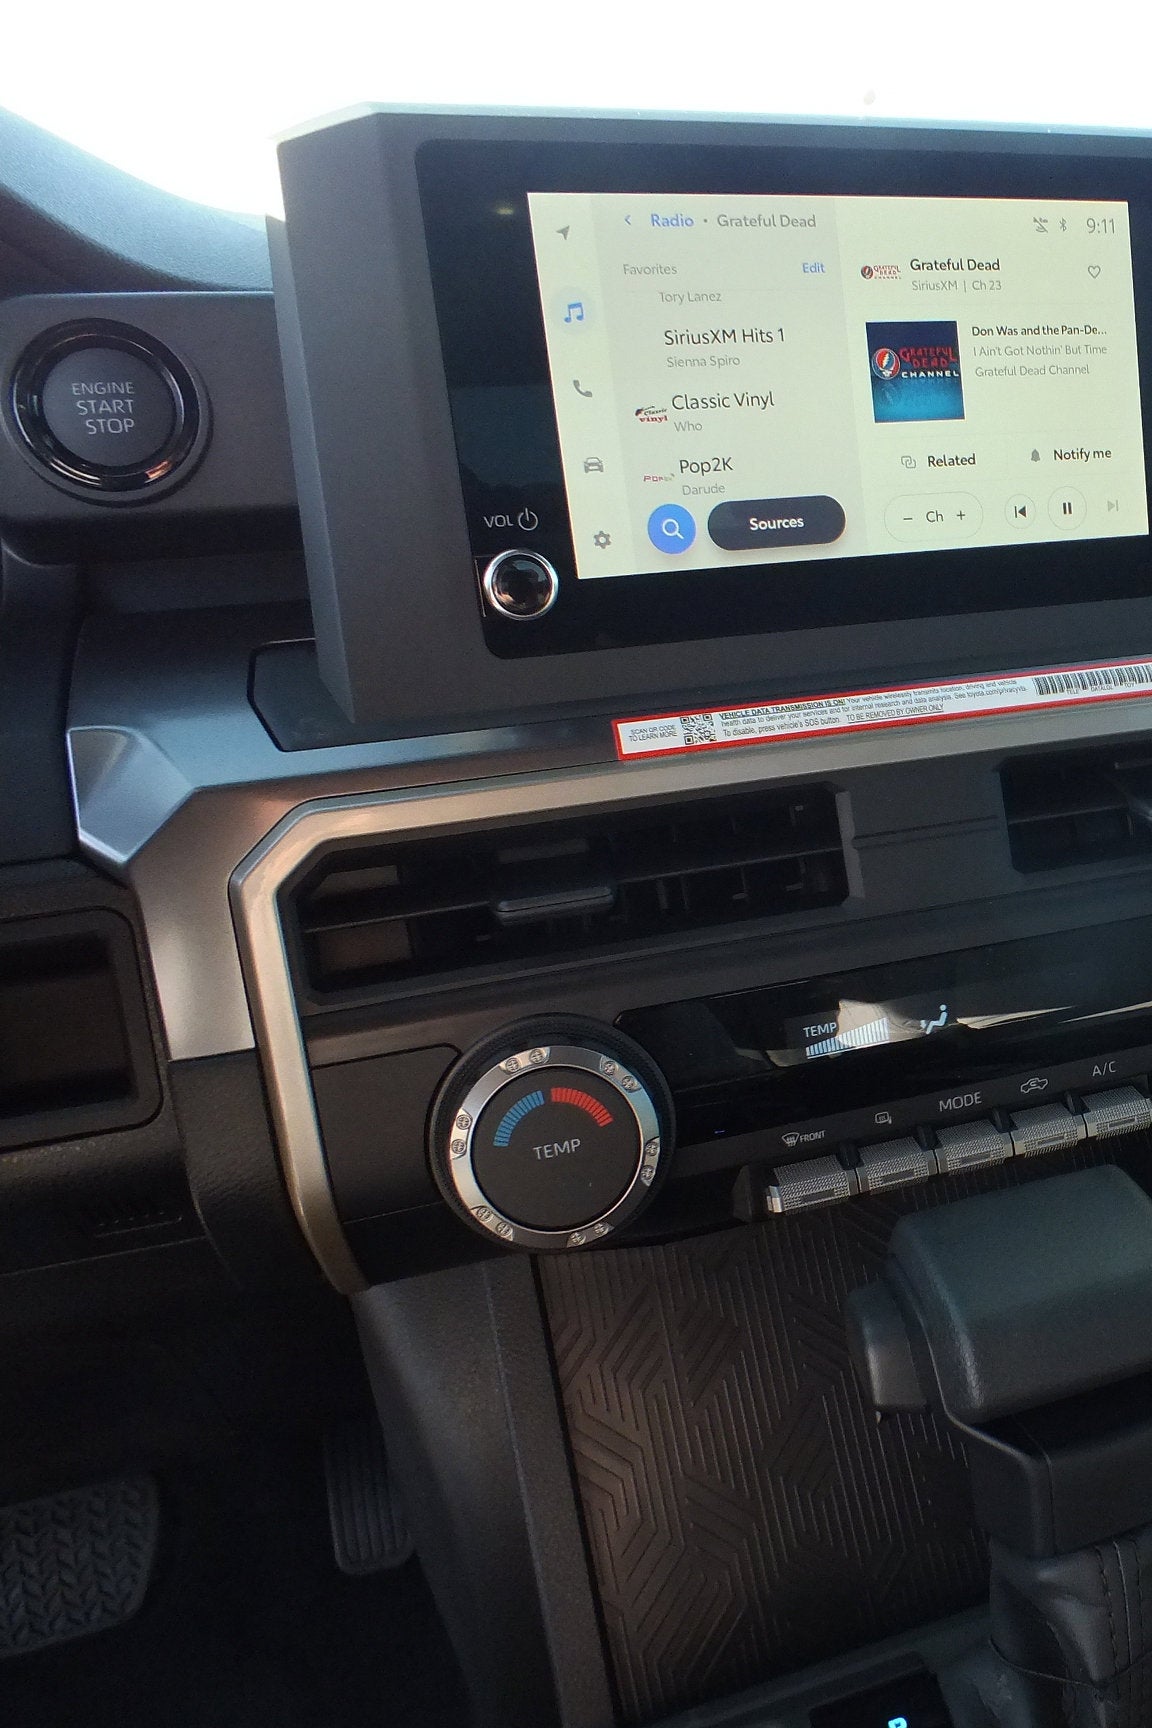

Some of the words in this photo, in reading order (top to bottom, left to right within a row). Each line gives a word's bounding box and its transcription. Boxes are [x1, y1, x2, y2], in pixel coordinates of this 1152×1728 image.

[650, 213, 695, 228] Radio
[717, 213, 777, 228] Grateful
[780, 214, 817, 228] Dead
[1086, 218, 1117, 234] 9:11
[623, 264, 678, 275] Favorites
[802, 262, 826, 274] Edit
[910, 258, 964, 272] Grateful
[967, 259, 1001, 272] Dead
[911, 280, 959, 291] SiriusXM
[972, 280, 987, 291] Ch
[989, 280, 1002, 291] 23
[659, 291, 685, 305] Tory
[688, 291, 722, 302] Lanez
[664, 329, 737, 346] SiriusXM
[742, 329, 774, 344] Hits
[777, 329, 786, 342] 1
[972, 326, 994, 337] Don
[996, 325, 1019, 336] Was
[1021, 325, 1040, 336] and
[1042, 325, 1060, 336] the
[1061, 325, 1108, 336] Pan-De...
[899, 347, 958, 362] GRATEFUL
[977, 346, 1002, 356] Ain't
[1004, 346, 1024, 356] Got
[1026, 345, 1064, 356] Nothin'
[1065, 345, 1082, 355] But
[1084, 345, 1108, 355] Time
[667, 356, 707, 369] Sienna
[710, 355, 741, 369] Spiro
[913, 358, 948, 368] DEAD
[901, 370, 959, 379] CHANNEL
[975, 365, 1017, 377] Grateful
[1020, 365, 1047, 376] Dead
[1049, 364, 1090, 376] Channel
[72, 382, 135, 396] ENGINE
[77, 400, 134, 416] START
[672, 394, 731, 411] Classic
[734, 392, 775, 411] Vinyl
[86, 419, 135, 435] STOP
[674, 421, 703, 433] Who
[927, 454, 977, 468] Related
[1053, 449, 1091, 463] Notify
[1093, 450, 1112, 460] me
[680, 457, 734, 476] Pop2K
[682, 483, 726, 496] Darude
[484, 515, 514, 528] VOL
[750, 516, 805, 532] Sources
[926, 510, 944, 524] Ch
[719, 710, 750, 721] VEHICLE
[752, 707, 770, 717] DATA
[770, 702, 824, 714] TRANSMISSION
[721, 720, 741, 728] health
[766, 714, 786, 722] deliver
[723, 729, 732, 737] To
[759, 725, 776, 734] press
[805, 718, 820, 727] SOS
[847, 714, 856, 722] TO
[866, 709, 896, 719] REMOVED
[906, 706, 928, 715] OWNER
[929, 704, 944, 712] ONLY
[639, 733, 659, 741] LEARN
[803, 1022, 837, 1038] TEMP
[1092, 1061, 1117, 1078] A/C
[939, 1091, 982, 1112] MODE
[800, 1130, 826, 1143] FRONT
[532, 1138, 582, 1160] TEMP
